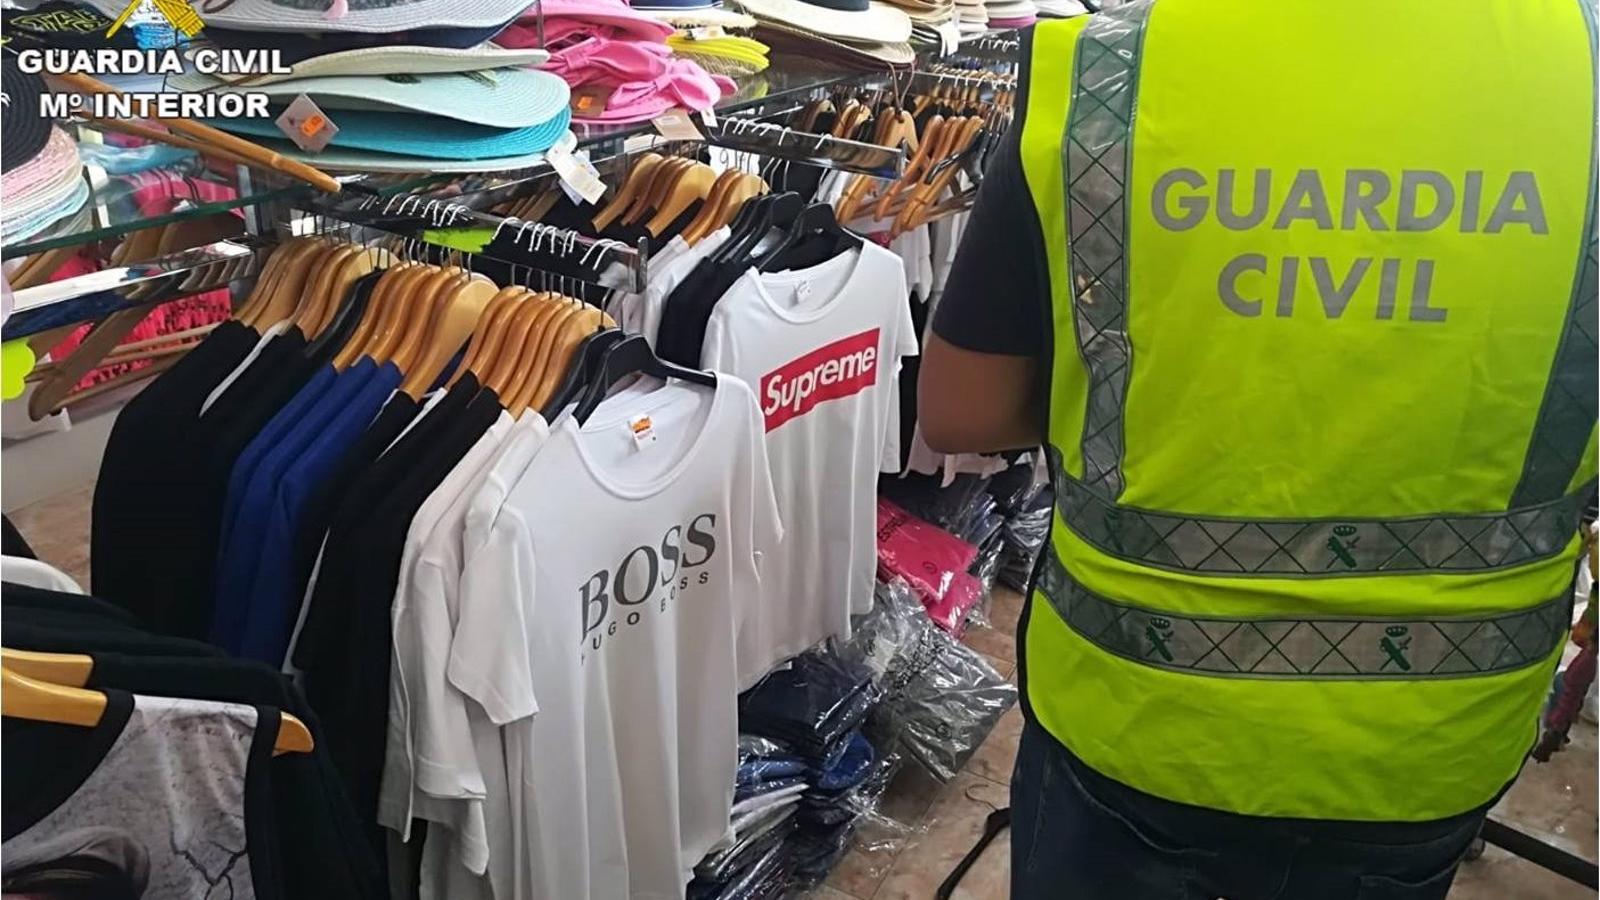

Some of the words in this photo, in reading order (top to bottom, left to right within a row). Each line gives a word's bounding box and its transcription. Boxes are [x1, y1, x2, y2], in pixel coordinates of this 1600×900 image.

[1151, 167, 1549, 235] GUARDIA
[1216, 252, 1449, 323] CIVIL
[764, 346, 876, 416] Supreme
[578, 513, 717, 645] BOSS
[579, 611, 641, 666] UGO
